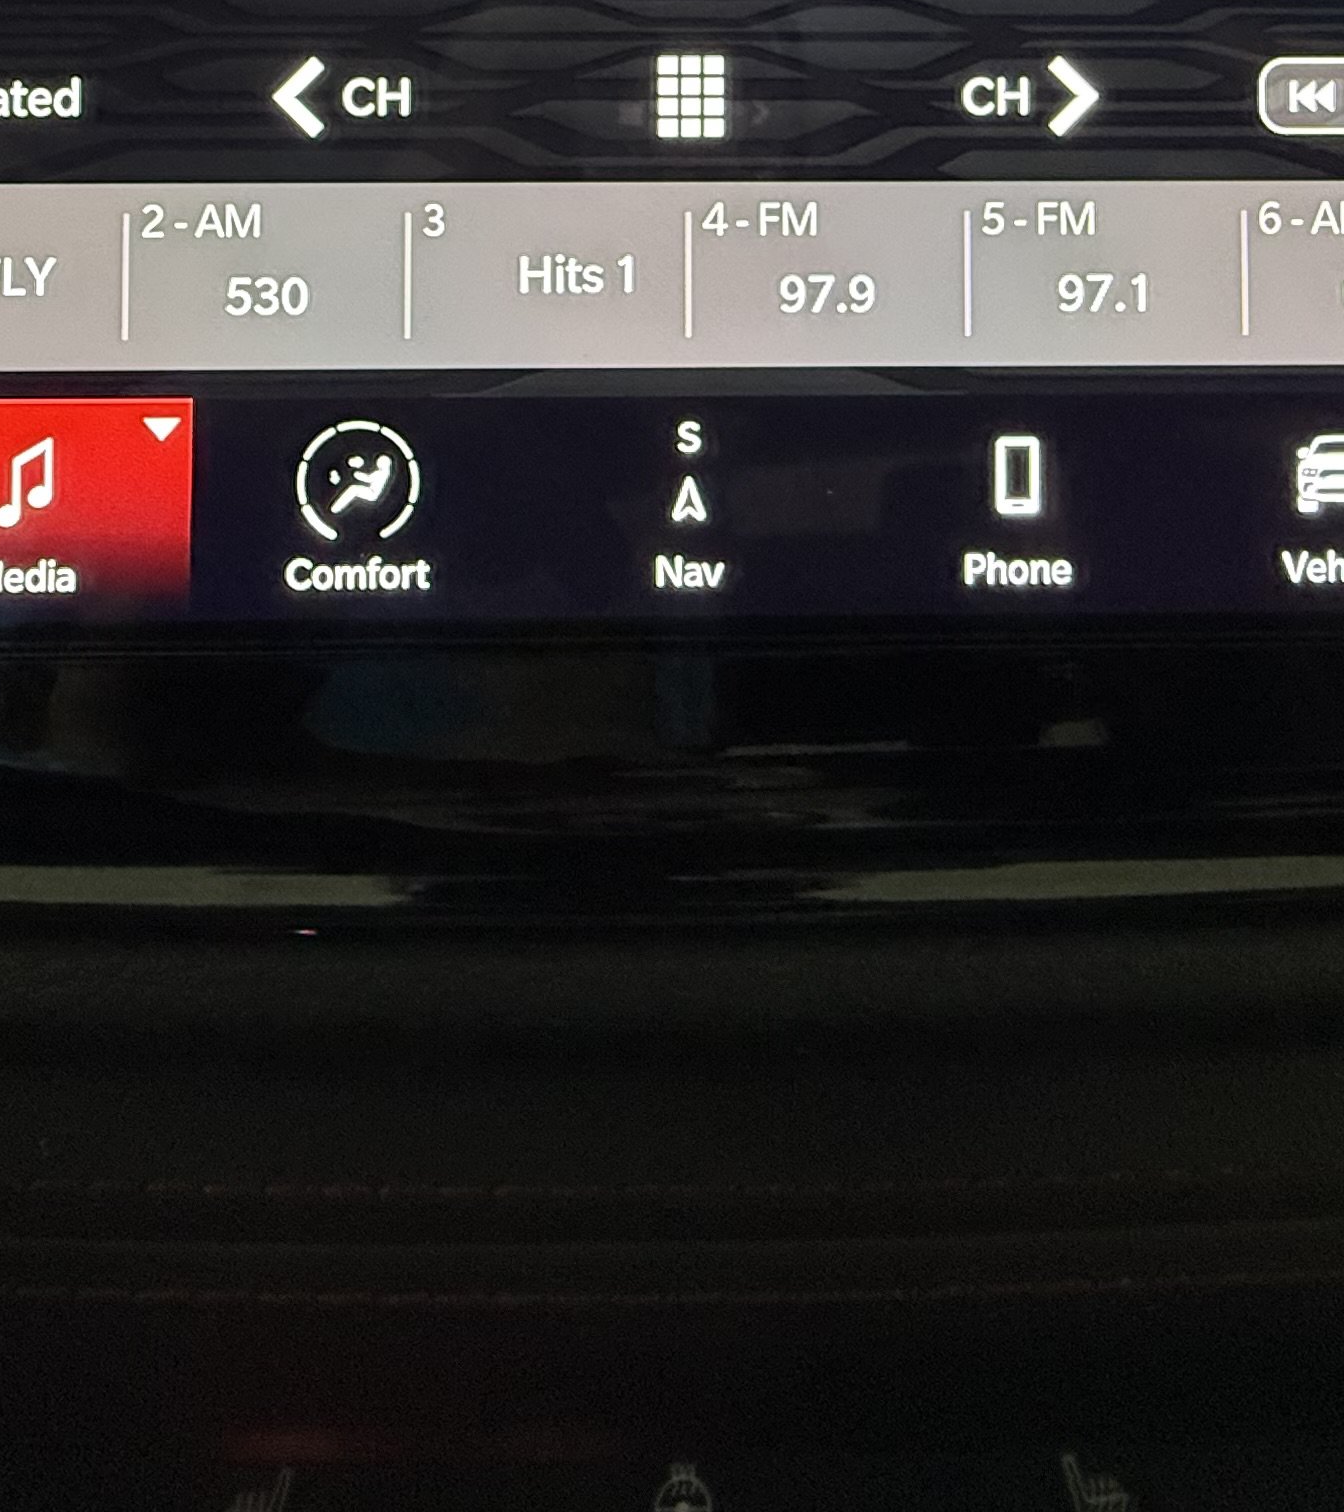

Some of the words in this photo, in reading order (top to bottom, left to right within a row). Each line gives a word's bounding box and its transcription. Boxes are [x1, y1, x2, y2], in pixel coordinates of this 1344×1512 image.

[340, 75, 413, 118] CH
[959, 74, 1032, 118] CH
[421, 202, 446, 238] 3
[518, 252, 605, 295] Hits
[616, 254, 634, 295] 1
[779, 273, 876, 315] 97.9
[1057, 272, 1148, 314] 97.1
[224, 275, 310, 317] 530
[675, 419, 704, 456] S
[283, 554, 432, 593] Comfort
[654, 553, 727, 590] Nav
[962, 550, 1074, 589] Phone
